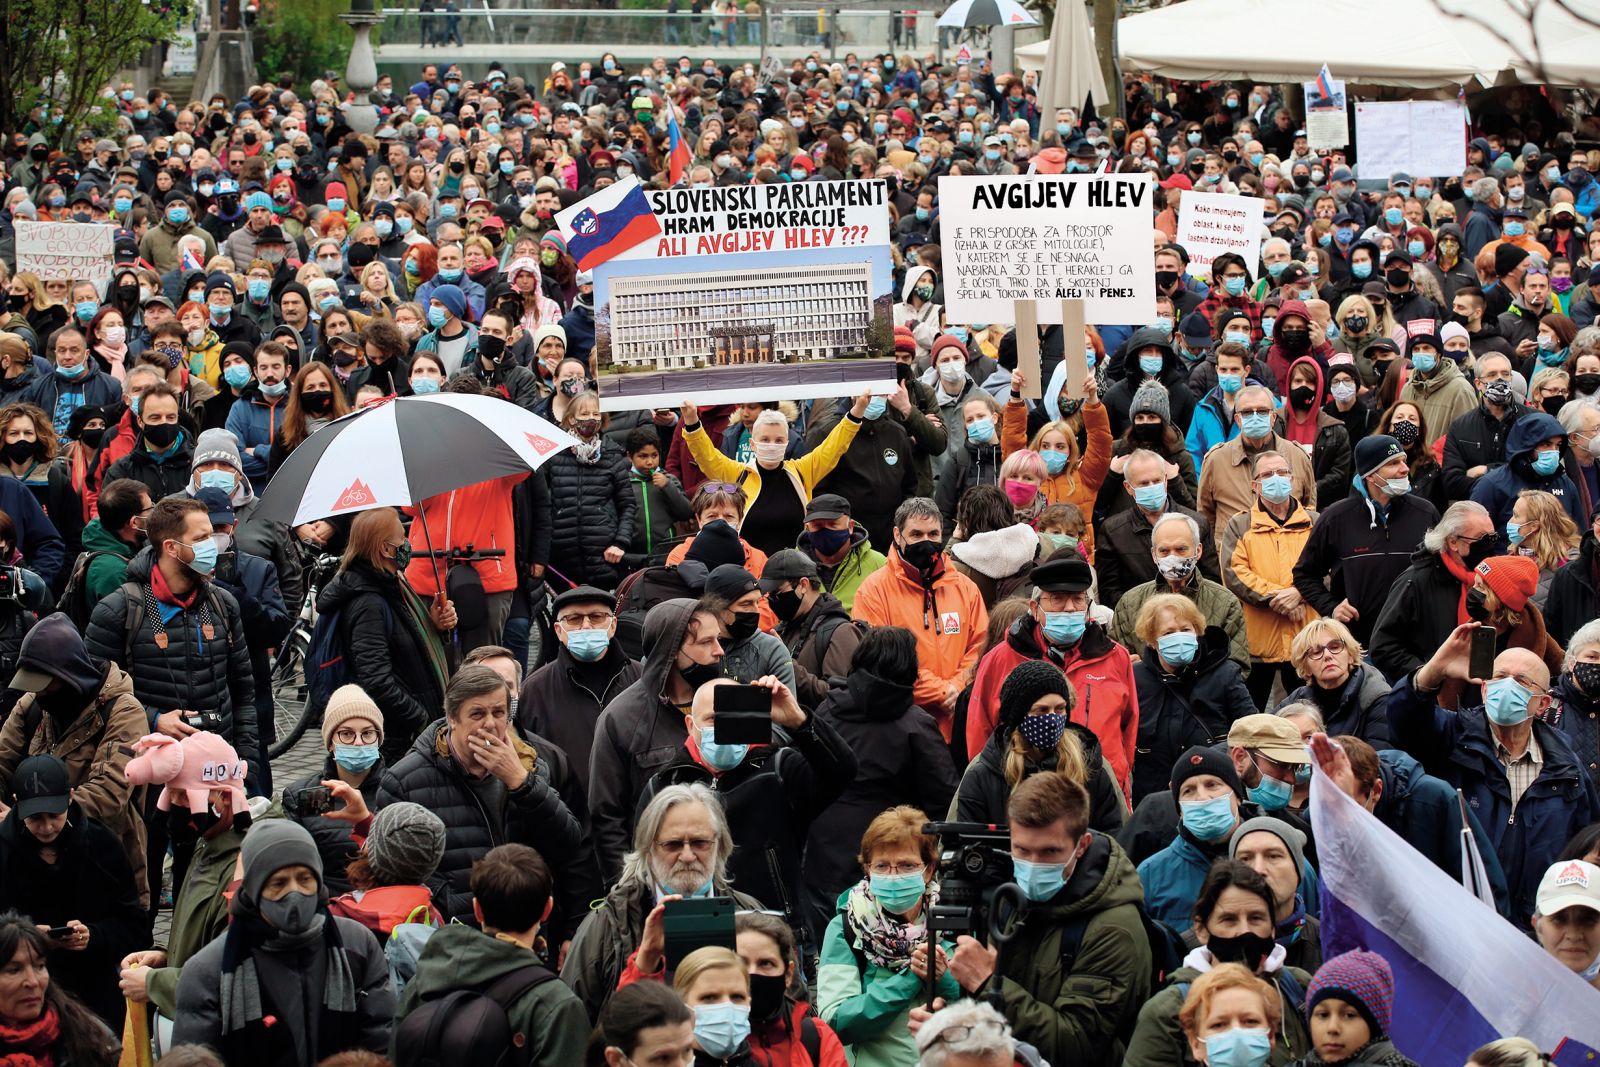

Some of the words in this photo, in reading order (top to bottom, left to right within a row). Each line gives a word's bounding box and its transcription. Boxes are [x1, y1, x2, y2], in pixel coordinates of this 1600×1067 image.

[653, 186, 757, 215] SLOVENSKI
[766, 181, 886, 210] PARLAMENT
[972, 181, 1077, 209] AVGIJEV
[1088, 180, 1146, 208] HLEV
[1194, 204, 1210, 214] Kako
[1212, 207, 1246, 218] imenujemo
[664, 216, 714, 235] HRAM
[727, 208, 846, 231] DEMOKRACIJE
[20, 223, 110, 244] SVOBODA
[954, 227, 963, 239] JE
[970, 227, 1037, 239] PRISPODOBA
[1043, 225, 1060, 238] ZA
[1066, 225, 1113, 238] PROSTOR
[657, 237, 687, 257] ALI
[697, 230, 774, 254] AVGIJEV
[785, 228, 834, 249] HLEV
[954, 240, 989, 251] (IZHAJA
[994, 240, 1002, 250] IZ
[955, 252, 962, 263] V
[967, 252, 1010, 263] KATEREM
[1017, 252, 1028, 263] SE
[1033, 252, 1044, 263] JE
[1050, 252, 1100, 263] NESNAGA
[1188, 253, 1215, 265] #Vlad
[956, 264, 1007, 276] NABIRALA
[1013, 263, 1031, 276] 30
[1065, 264, 1113, 276] HERAKLEJ
[1119, 264, 1133, 275] GA
[959, 278, 967, 288] JE
[1036, 278, 1050, 288] DA
[1054, 278, 1063, 288] JE
[1068, 277, 1111, 288] SKOZENJ
[956, 289, 993, 299] SPELJAL
[996, 289, 1029, 299] TOKOVA
[1033, 289, 1051, 298] REK
[1055, 288, 1082, 298] ALFEJ
[1085, 289, 1095, 298] IN
[1099, 287, 1136, 298] PENEJ.
